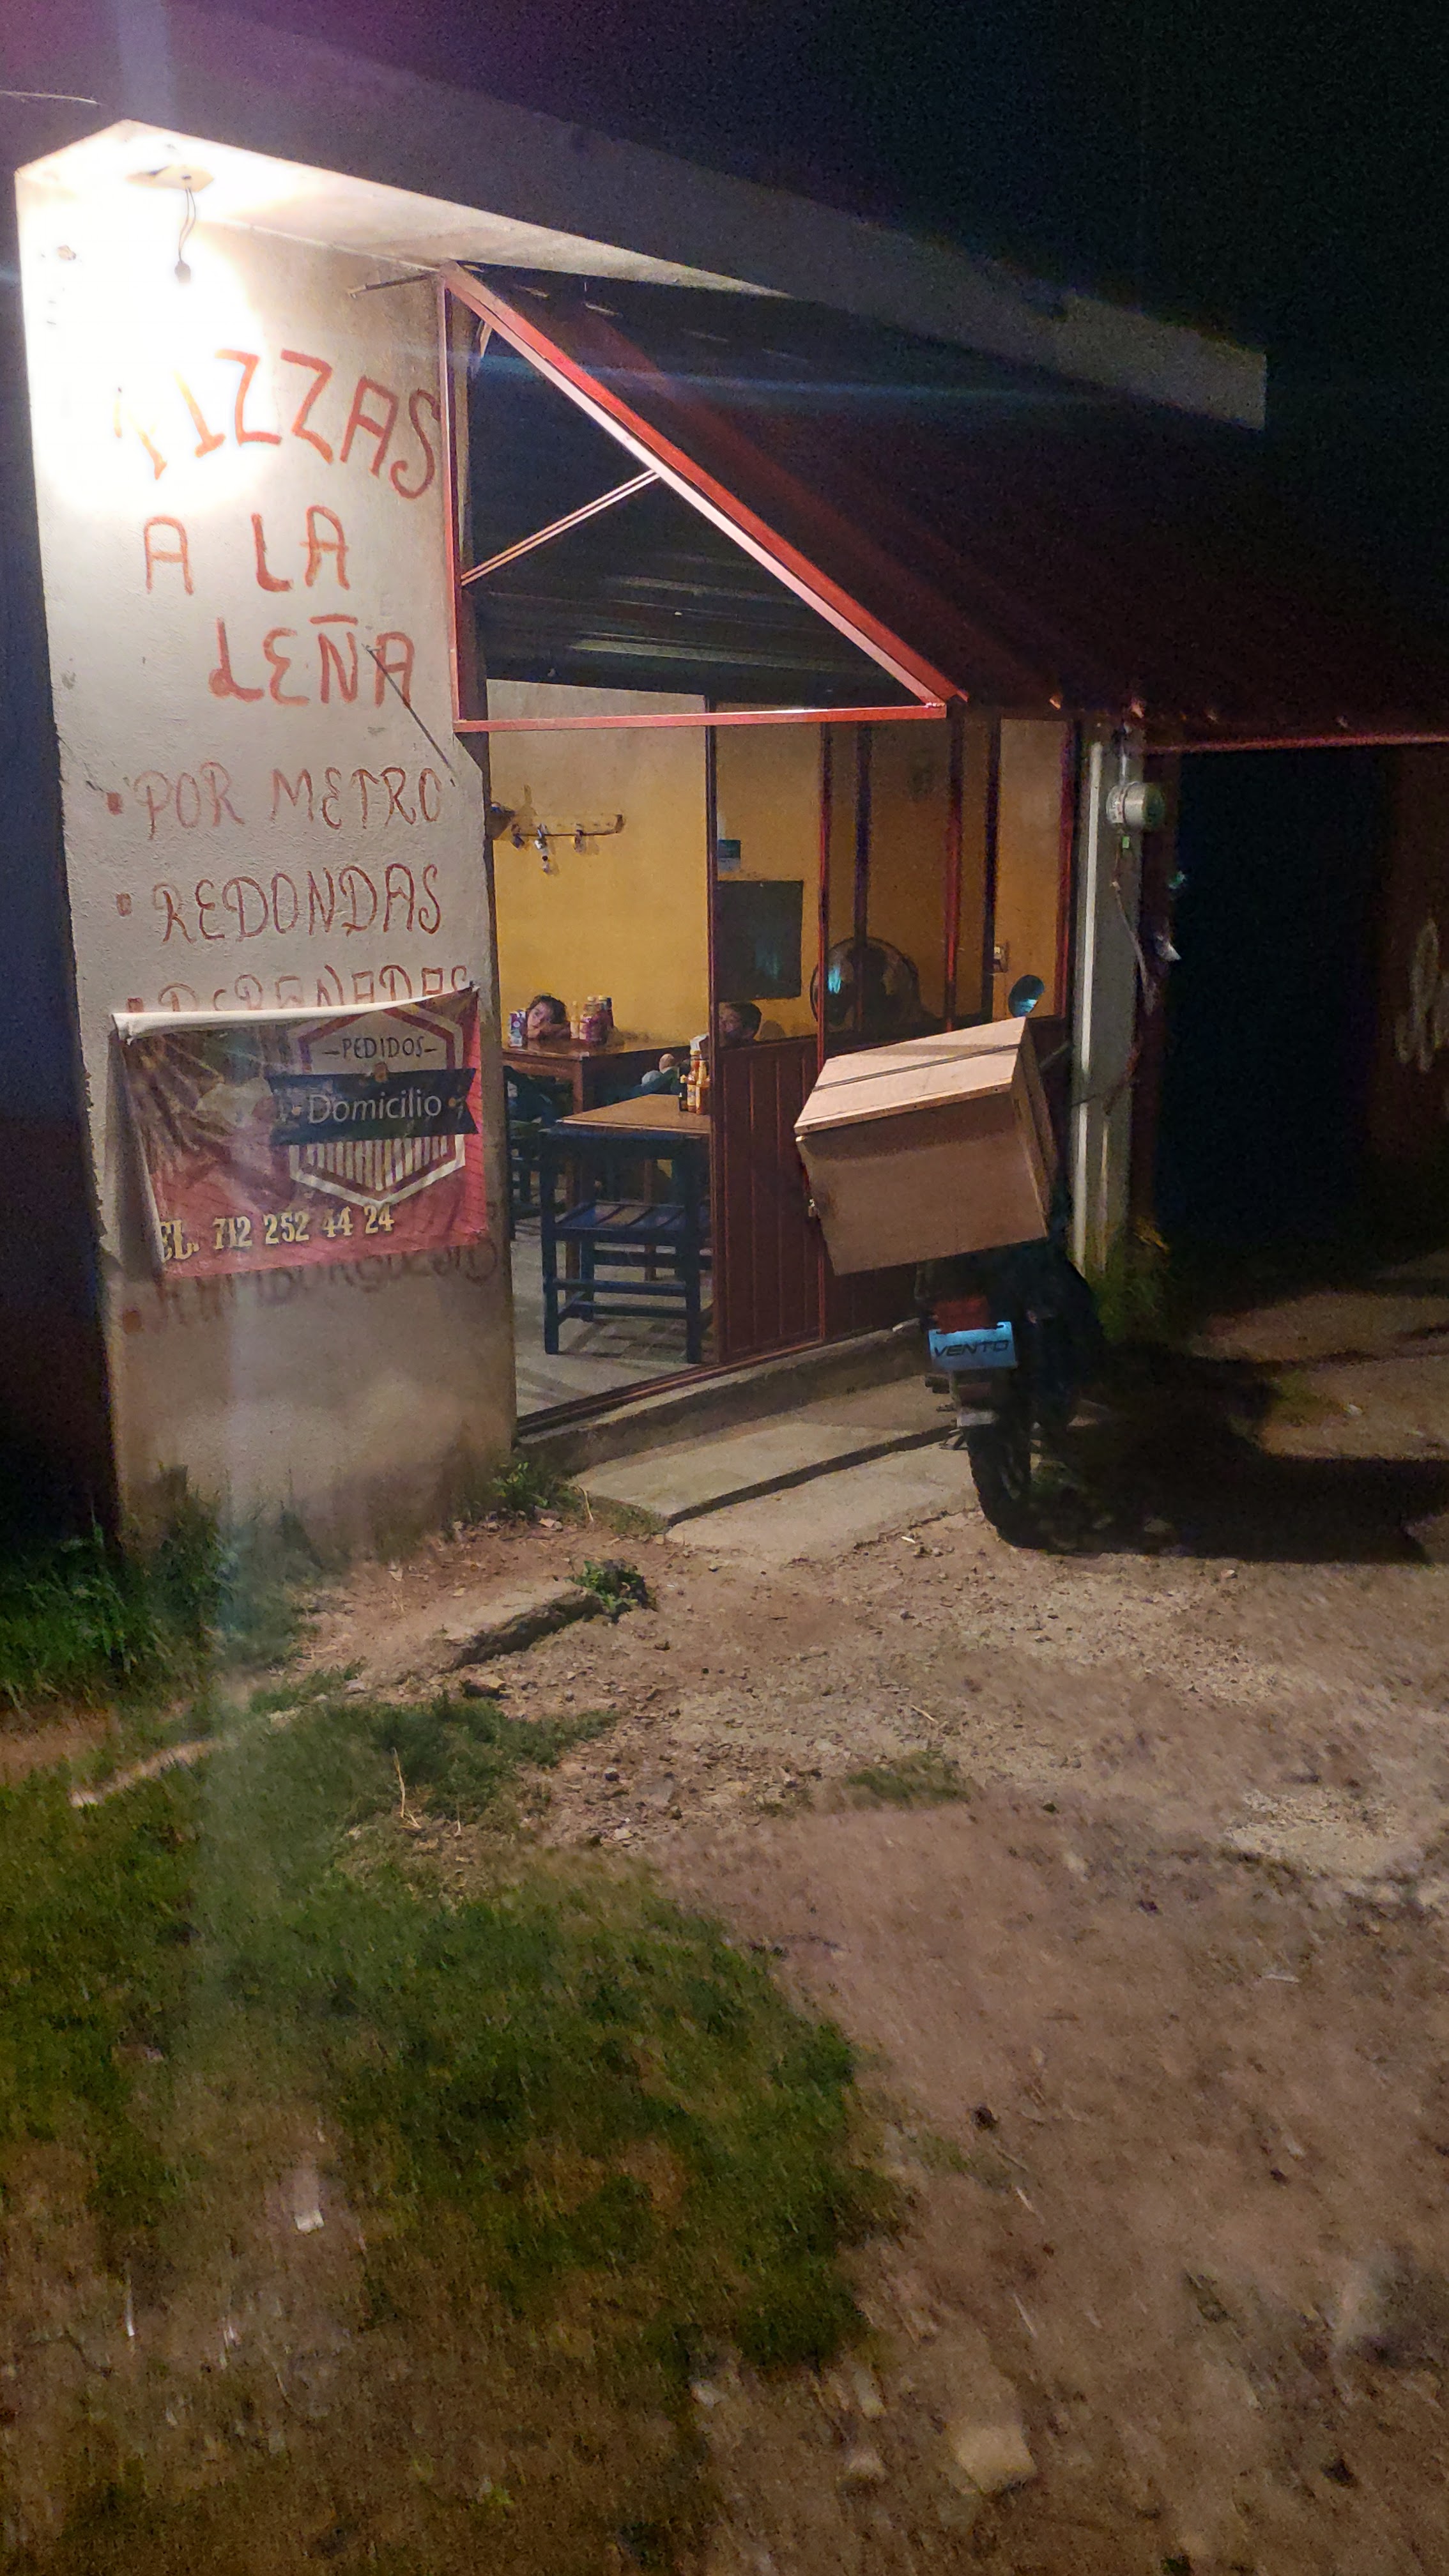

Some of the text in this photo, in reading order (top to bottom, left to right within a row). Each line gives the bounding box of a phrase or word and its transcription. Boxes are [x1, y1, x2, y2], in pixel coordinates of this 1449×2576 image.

[114, 349, 442, 499] IZZAS
[143, 505, 350, 595] A LA
[209, 613, 415, 708] LEÑA
[133, 762, 443, 840] POR METRO
[152, 863, 441, 944] REDONDAS
[342, 1036, 425, 1059] PEDIDOS
[307, 1088, 442, 1123] Domicilio
[161, 1203, 395, 1263] EL. 712 252 44 24
[933, 1340, 1009, 1357] VENTO
